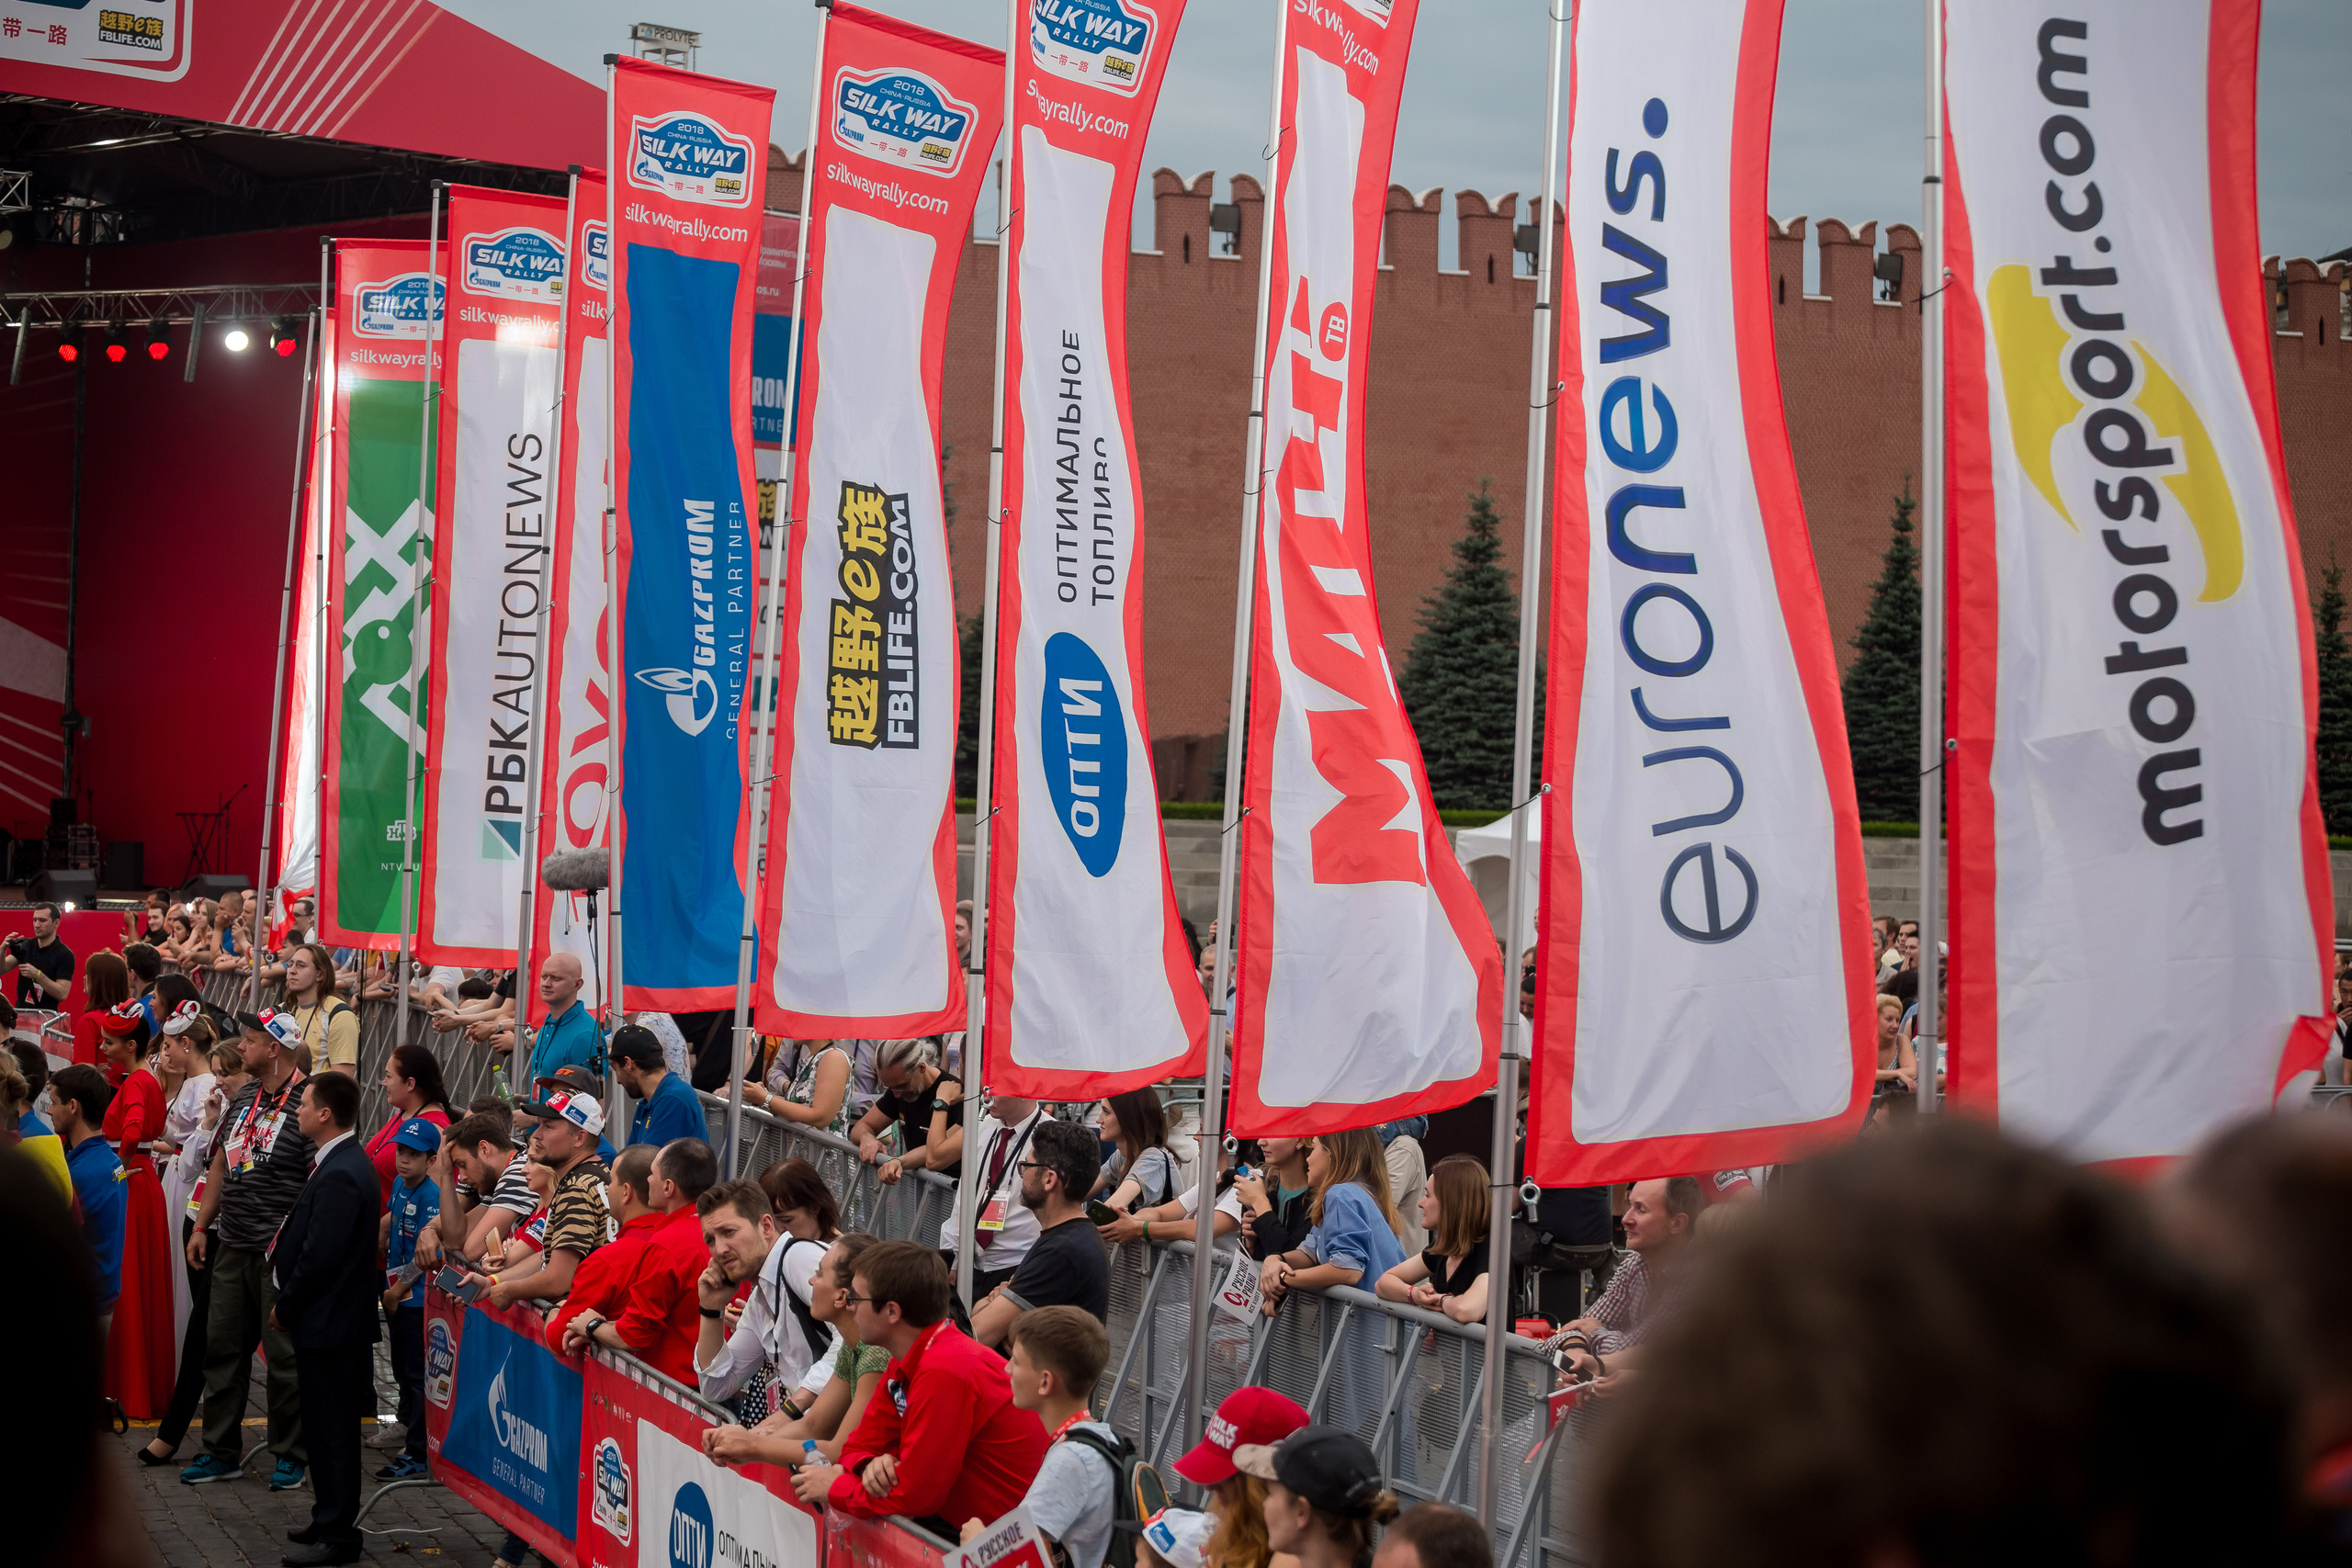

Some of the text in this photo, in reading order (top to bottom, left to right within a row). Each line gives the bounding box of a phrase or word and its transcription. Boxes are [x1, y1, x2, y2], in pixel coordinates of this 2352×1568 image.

[99, 11, 164, 38] 越野e族
[99, 30, 162, 50] FBLIFE.COM
[1052, 28, 1101, 49] RALLY
[1085, 12, 1143, 46] WAY
[893, 79, 925, 96] 2018
[1103, 66, 1132, 81] FBLIFE.COM
[843, 87, 959, 135] SILK WAY
[677, 122, 705, 135] 2018
[871, 119, 920, 138] RALLY
[641, 134, 741, 168] SILK WAY
[664, 161, 710, 175] RALLY
[827, 162, 949, 215] silkwayrally.com
[514, 236, 539, 246] 2018
[475, 248, 527, 269] SILK
[504, 268, 544, 279] RALLY
[368, 295, 421, 310] SILK
[2036, 17, 2204, 847] motorsport.com
[1056, 329, 1083, 604] ОПТИМАЛЬНОЕ
[728, 501, 743, 615] PARTNER
[683, 498, 716, 668] GAZPROM
[830, 483, 887, 745] 越野e族
[885, 500, 918, 745] FBLIFE.COM
[1062, 677, 1103, 840] ОПТИ
[1231, 1258, 1250, 1292] РУССКОЕ
[1241, 1272, 1257, 1298] РАДИО
[434, 1349, 453, 1372] WAY
[511, 1415, 548, 1473] GAZPROM
[492, 1457, 545, 1506] GENERAL PARTNER
[610, 1475, 627, 1500] WAY
[673, 1507, 707, 1568] ОПТИ
[977, 1521, 1023, 1565] РУССКОЕ
